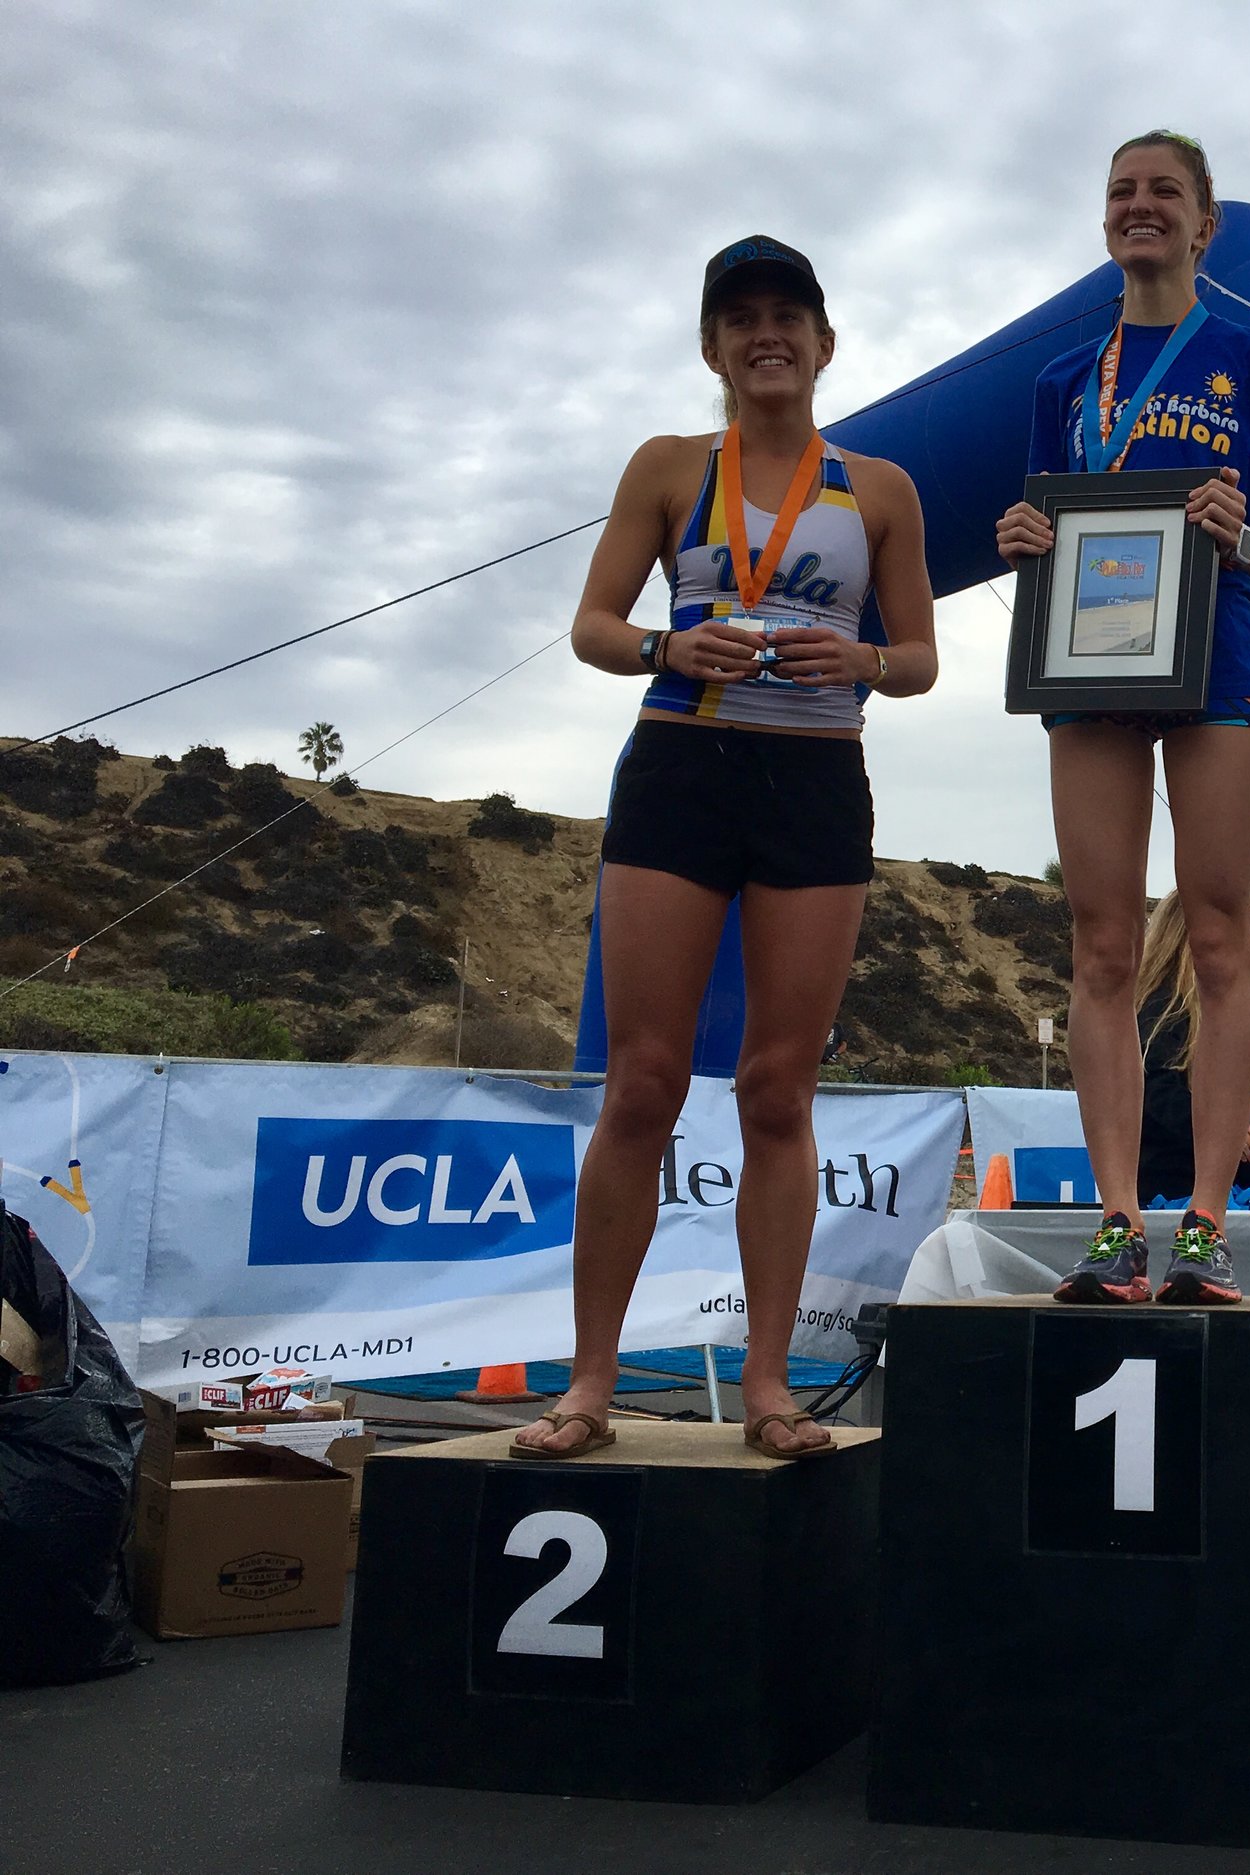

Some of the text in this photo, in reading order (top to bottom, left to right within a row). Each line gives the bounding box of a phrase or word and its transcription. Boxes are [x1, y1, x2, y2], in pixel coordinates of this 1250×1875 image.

[1167, 399, 1239, 433] Barbara
[302, 1153, 536, 1227] UCLA
[181, 1336, 413, 1369] 1-800-UCLA-MD1
[207, 1389, 225, 1401] CLIF
[254, 1389, 287, 1410] CLIF
[1074, 1358, 1156, 1511] 1
[496, 1510, 608, 1658] 2
